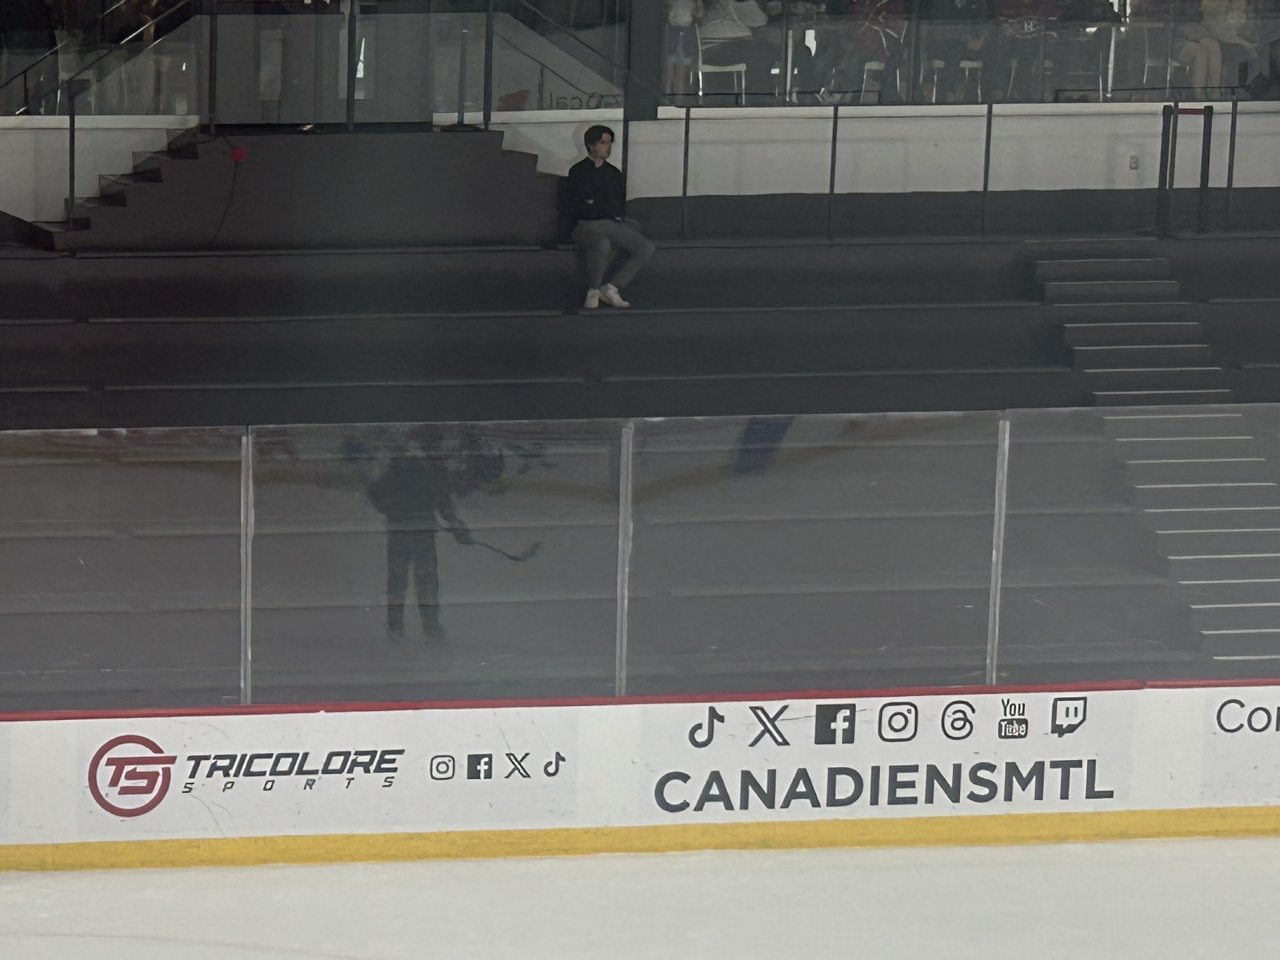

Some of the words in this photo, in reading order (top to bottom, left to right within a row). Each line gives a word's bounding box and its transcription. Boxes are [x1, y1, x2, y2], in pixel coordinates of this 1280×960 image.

[1001, 698, 1026, 717] You
[1216, 698, 1280, 733] Co
[185, 748, 406, 780] TRICOLORE
[654, 759, 1115, 814] CANADIENSMTL
